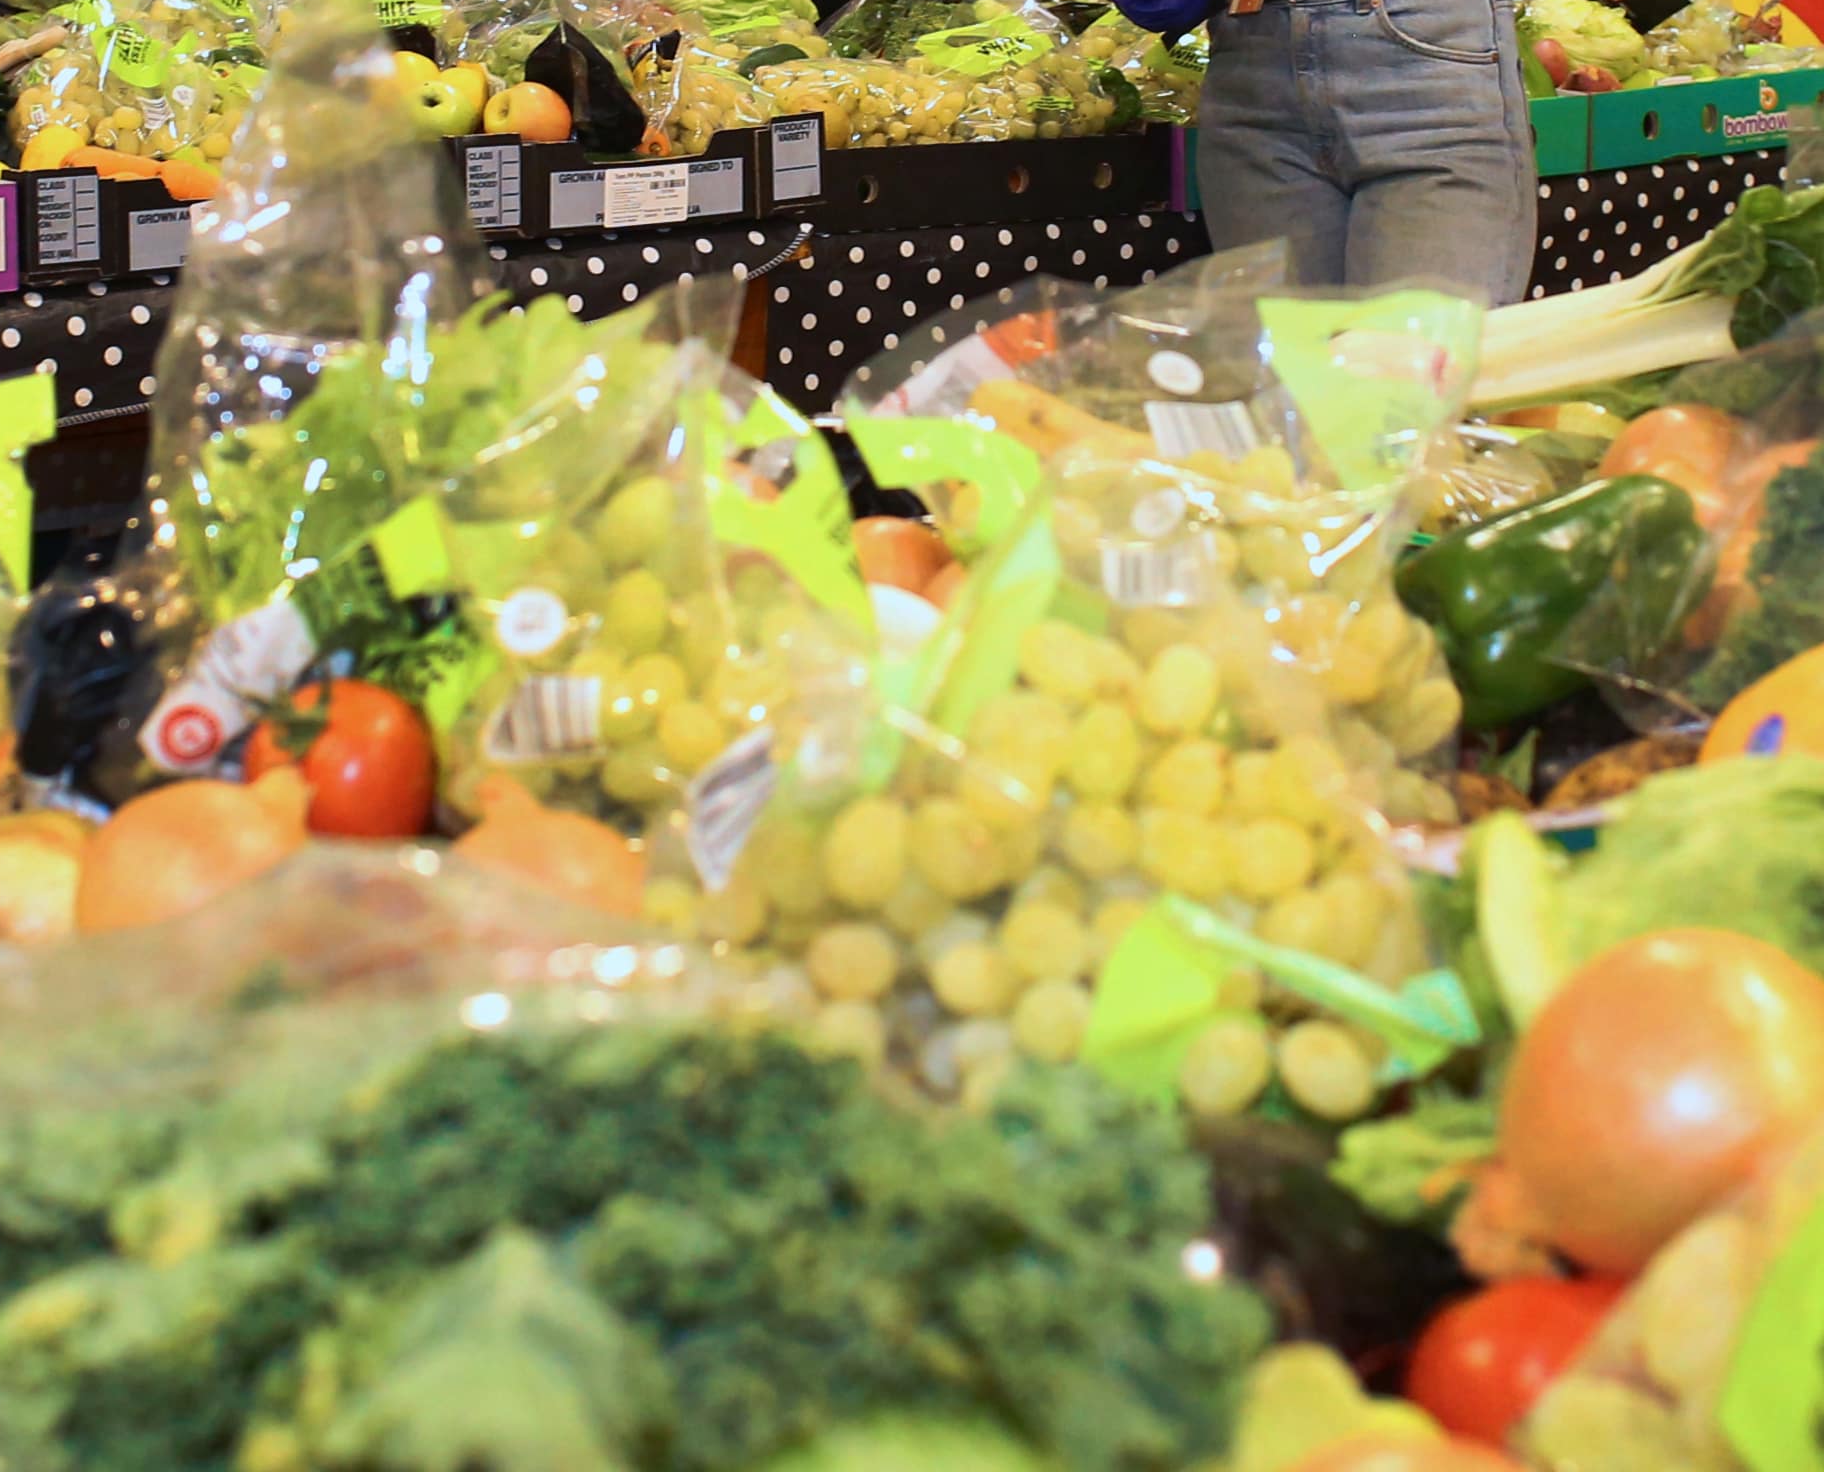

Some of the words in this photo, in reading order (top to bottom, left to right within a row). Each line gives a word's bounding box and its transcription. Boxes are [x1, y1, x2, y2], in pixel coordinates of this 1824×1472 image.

[378, 0, 417, 17] HITE
[1723, 110, 1789, 138] bombow
[39, 180, 66, 190] CLASS
[137, 213, 176, 225] GROWN
